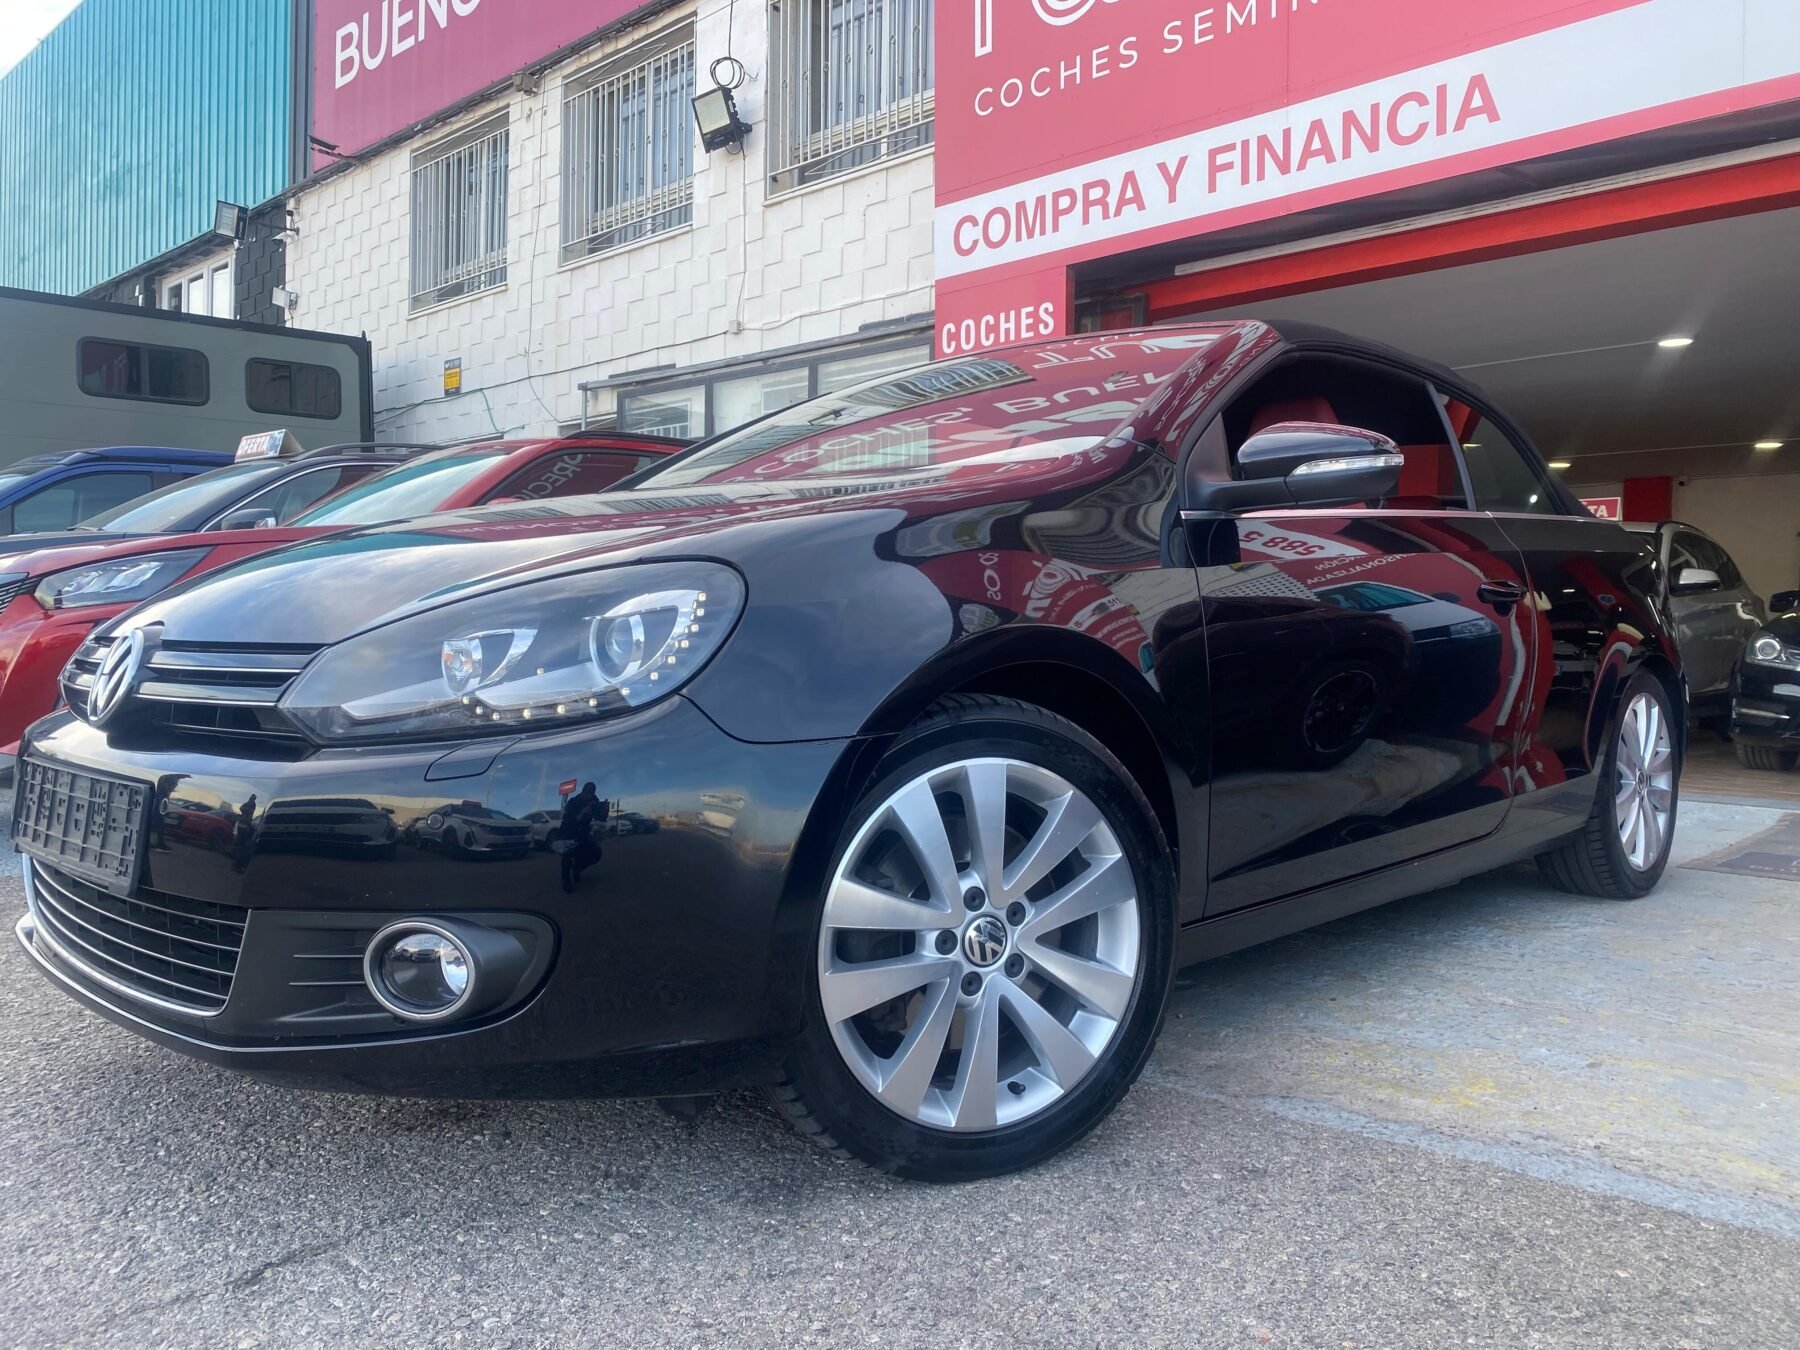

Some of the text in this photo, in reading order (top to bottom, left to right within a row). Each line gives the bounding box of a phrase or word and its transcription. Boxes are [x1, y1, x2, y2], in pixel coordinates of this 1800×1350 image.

[973, 36, 1139, 117] COCHES
[952, 72, 1502, 257] COMPRA Y FINANCIA
[941, 301, 1055, 354] COCHES
